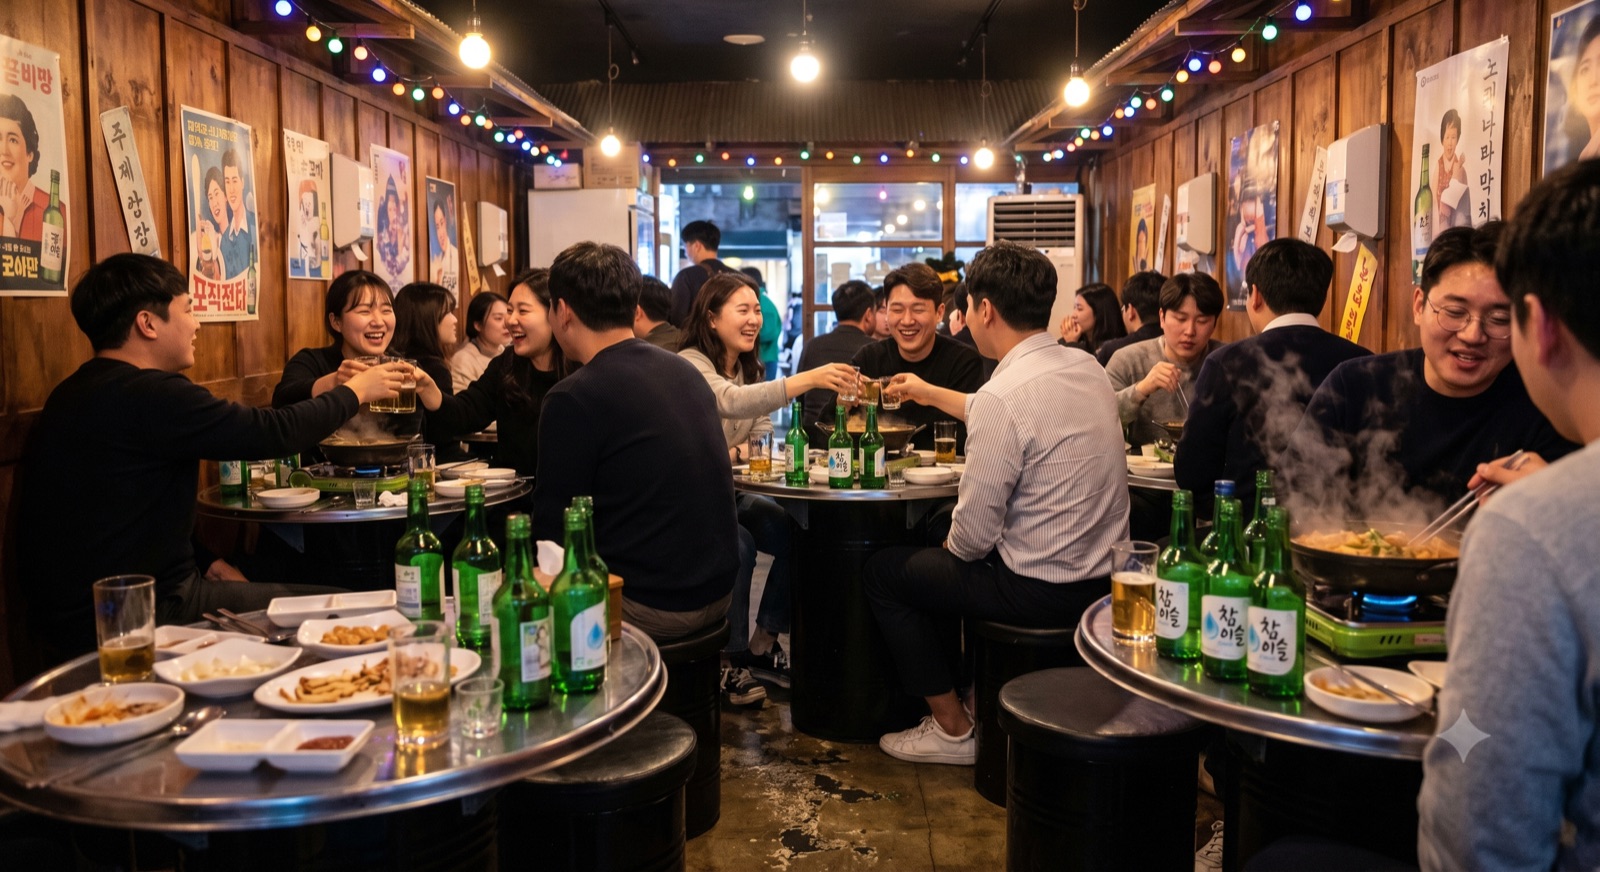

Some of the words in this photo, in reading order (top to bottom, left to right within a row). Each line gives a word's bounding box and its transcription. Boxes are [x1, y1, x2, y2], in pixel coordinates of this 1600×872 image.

[1158, 586, 1180, 628] 참이슬
[1218, 604, 1245, 647] 참이슬
[1260, 617, 1288, 662] 참이슬
